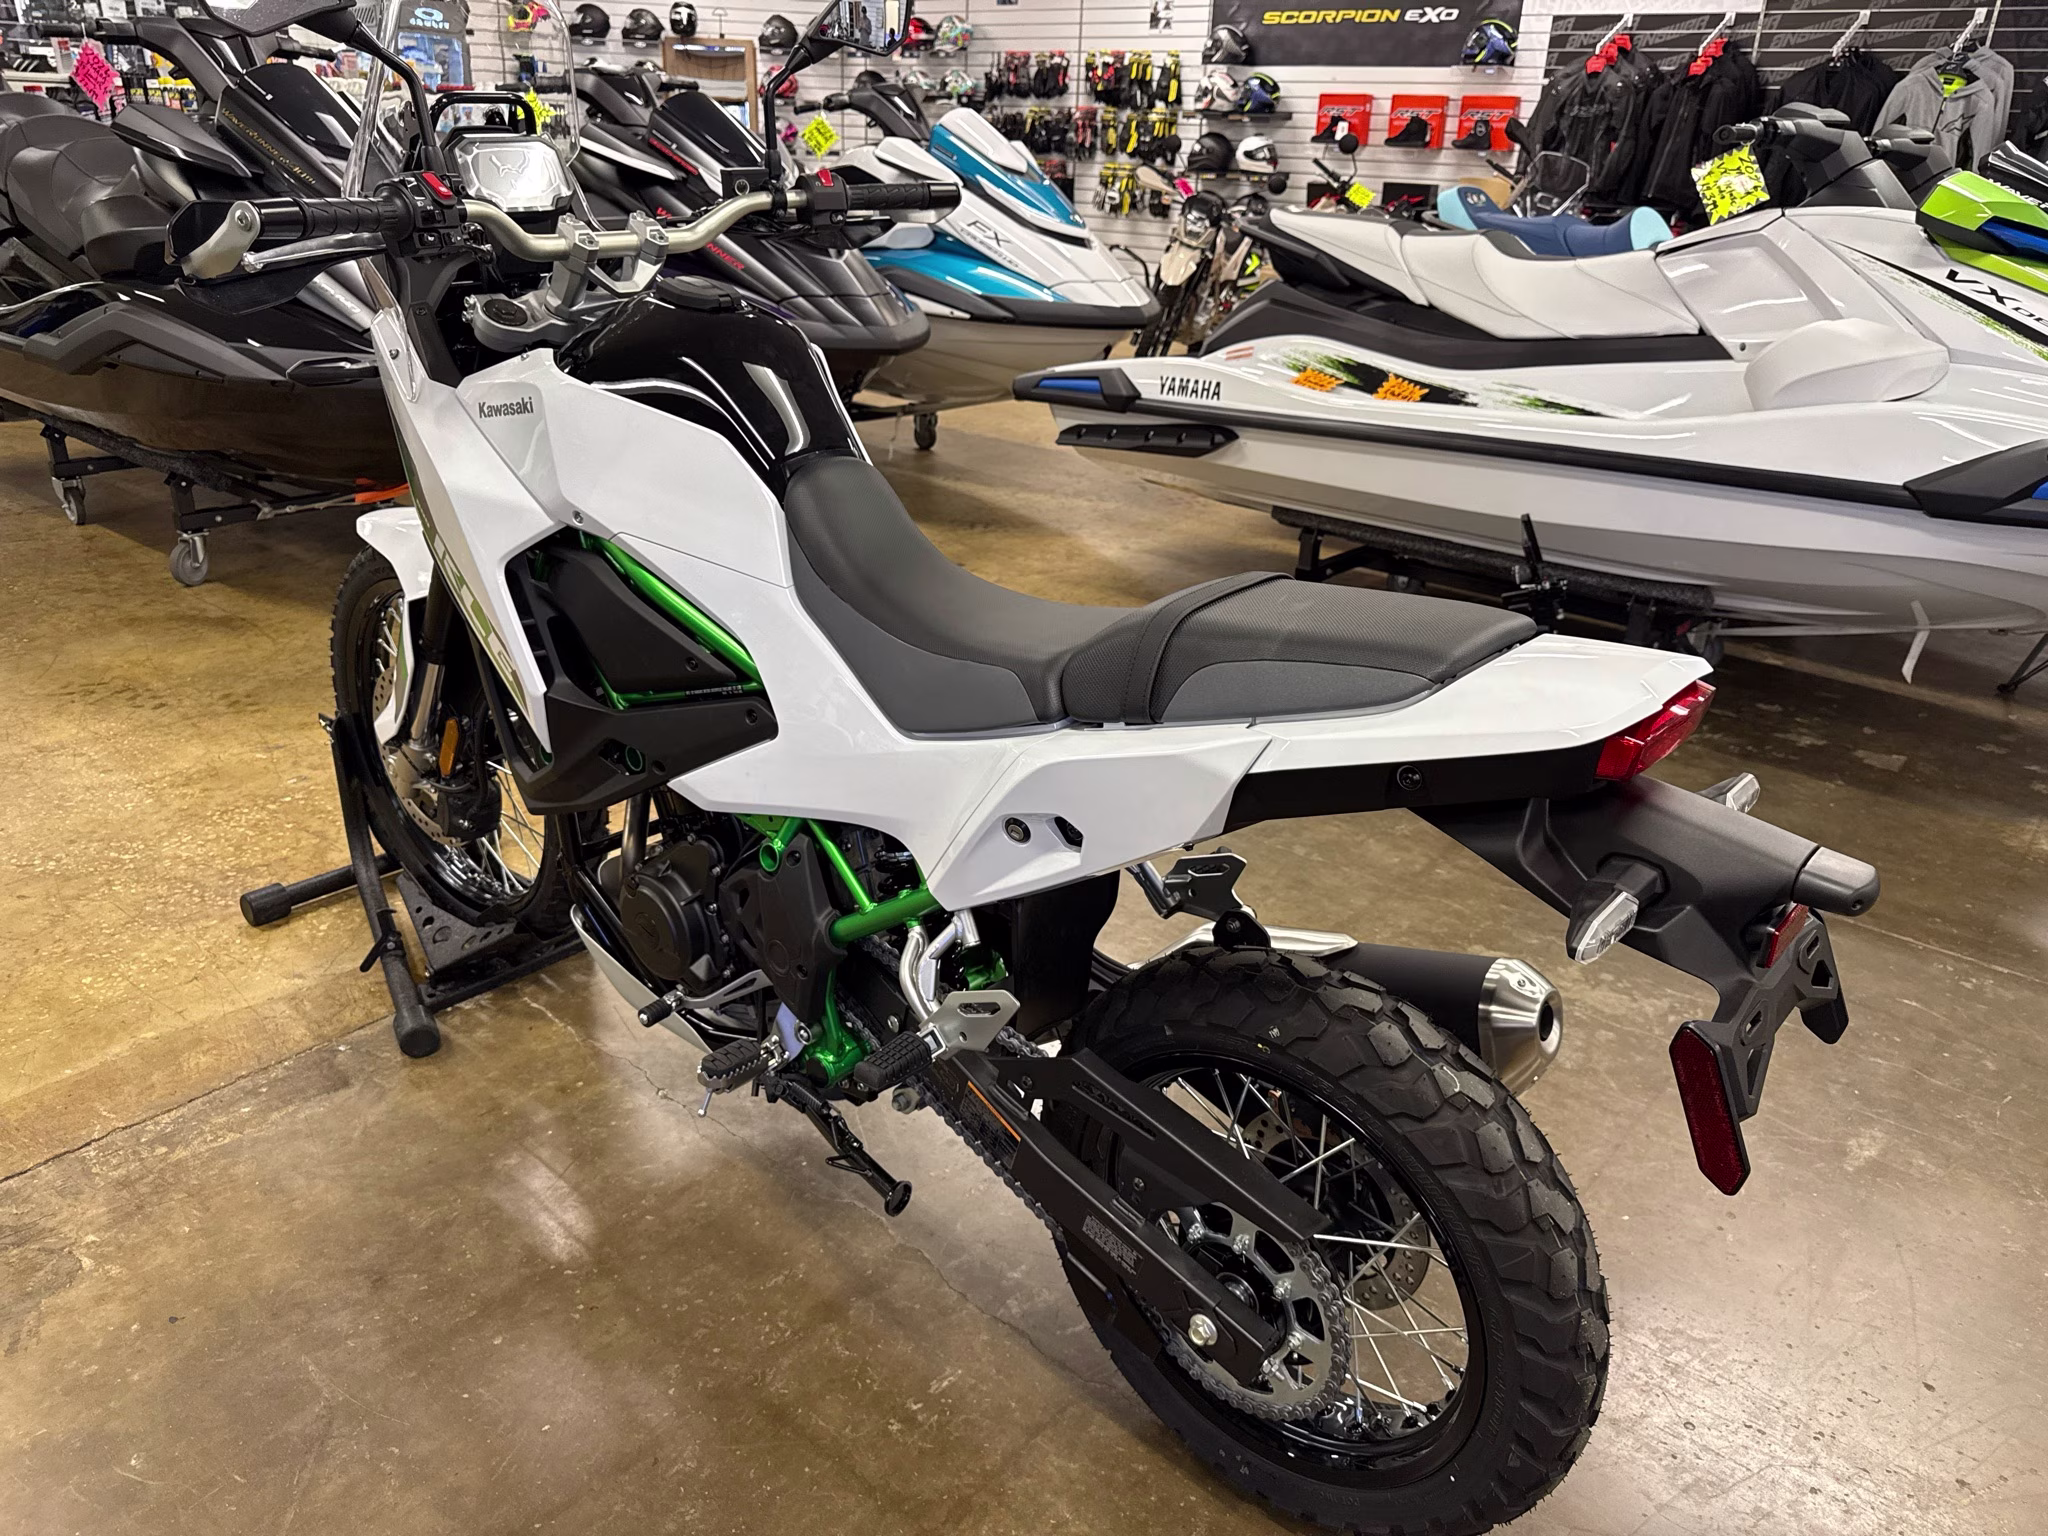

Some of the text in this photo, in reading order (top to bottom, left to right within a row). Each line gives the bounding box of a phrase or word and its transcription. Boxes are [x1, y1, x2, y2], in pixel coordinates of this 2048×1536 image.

[1262, 9, 1401, 25] SCORPION
[1319, 105, 1365, 117] RST
[1391, 107, 1443, 119] RST
[1460, 108, 1514, 120] RST
[966, 219, 1013, 248] FX
[1945, 268, 2023, 307] VX
[1159, 375, 1221, 401] YAMAHA
[478, 396, 534, 419] Kawasaki
